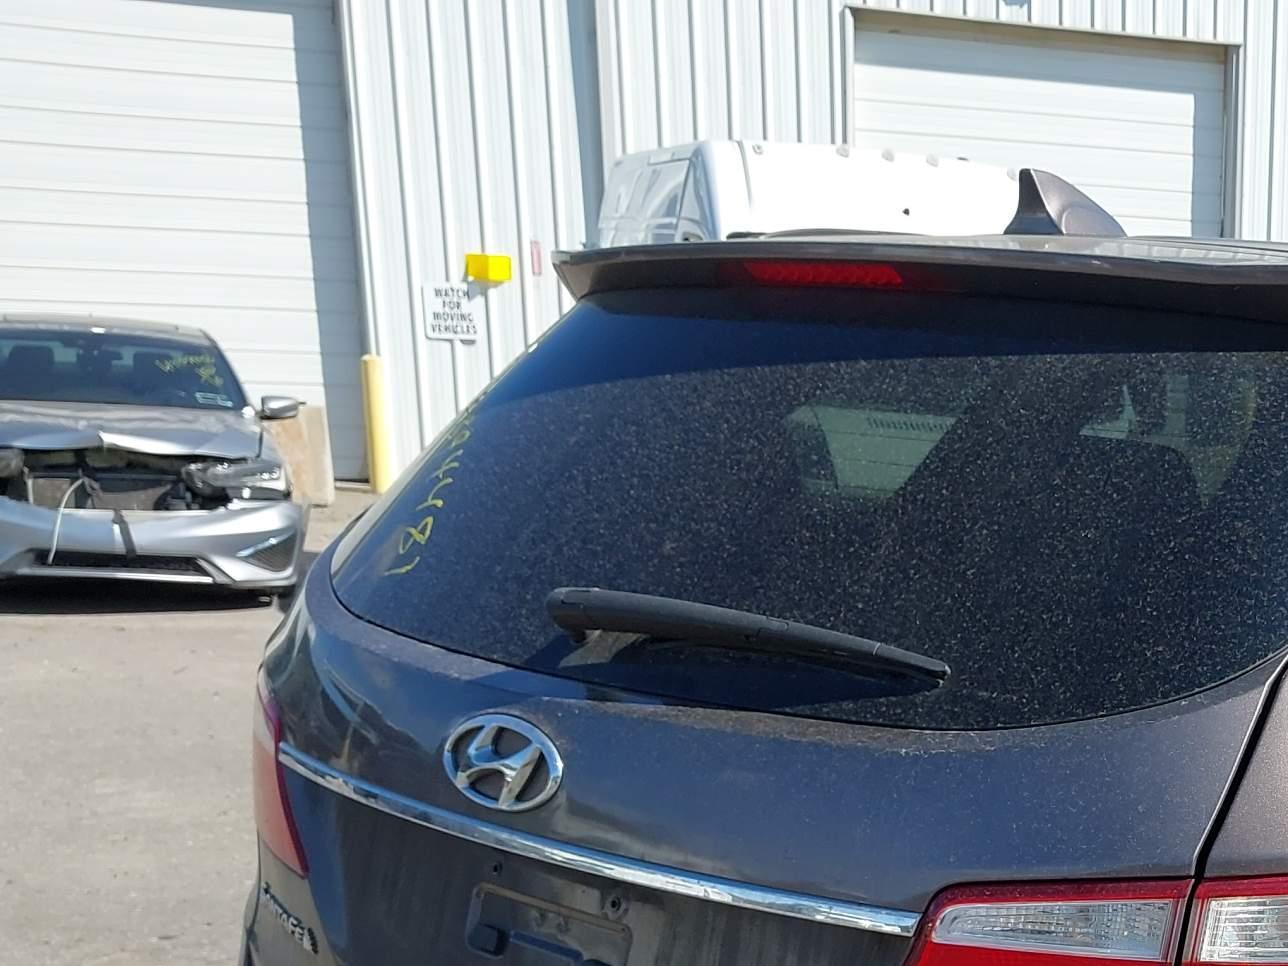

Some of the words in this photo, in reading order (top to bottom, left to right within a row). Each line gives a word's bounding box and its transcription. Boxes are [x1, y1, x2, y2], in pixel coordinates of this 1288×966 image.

[434, 288, 470, 298] WATCH
[442, 301, 462, 310] FOR
[433, 313, 474, 322] MOVING
[431, 324, 477, 335] VEHICLES
